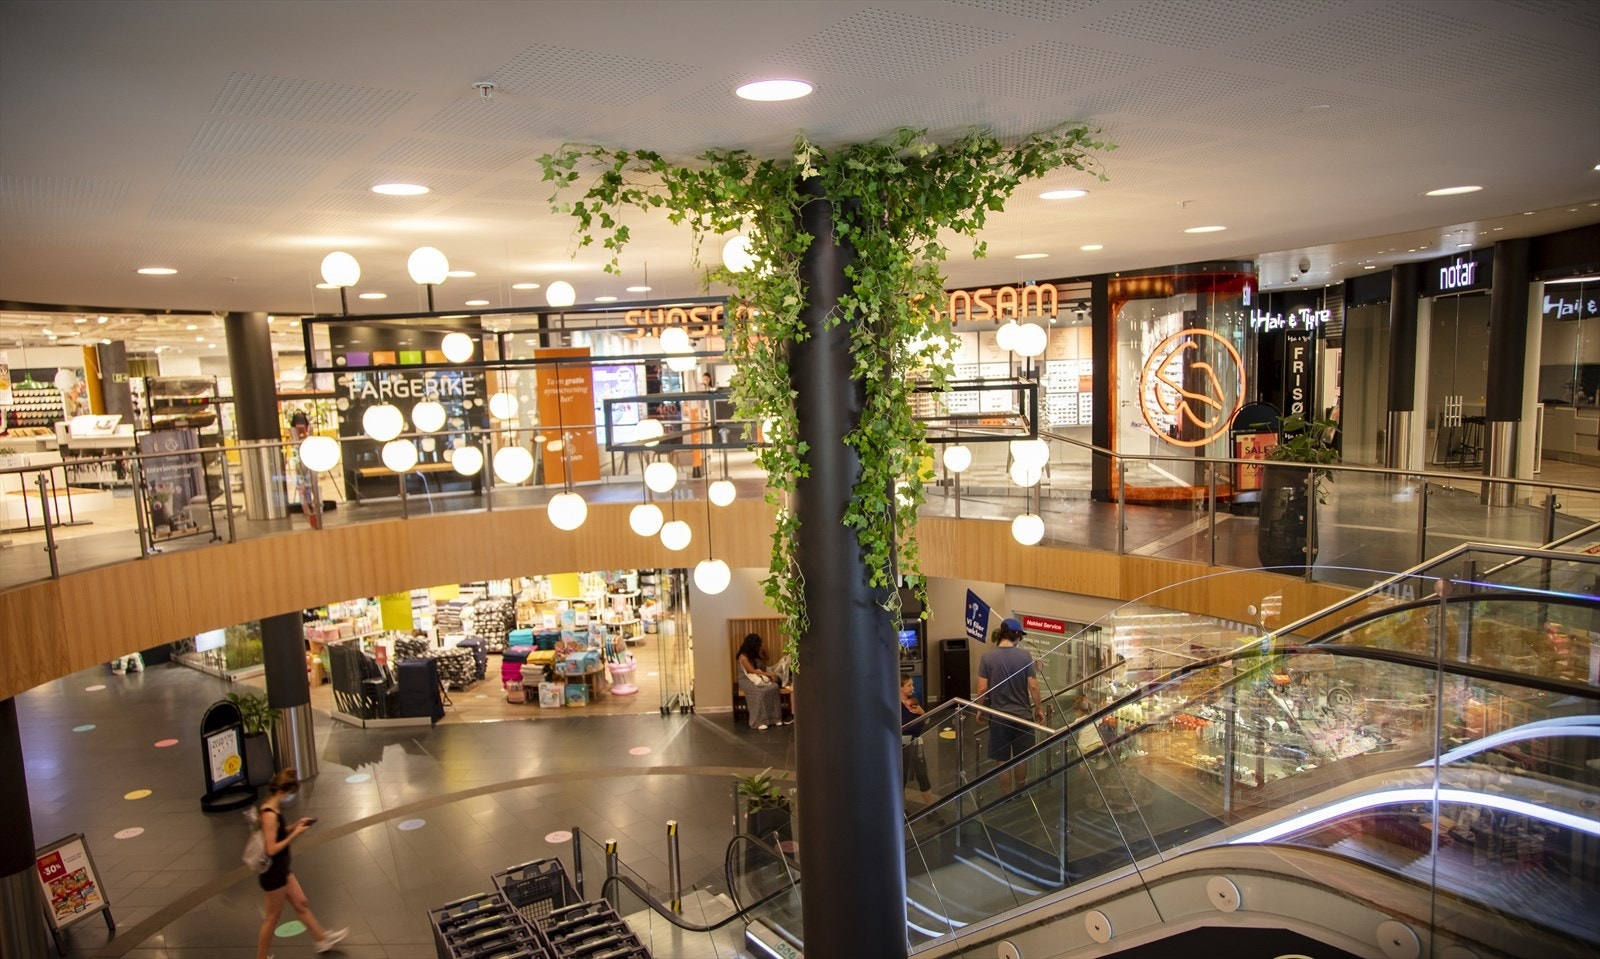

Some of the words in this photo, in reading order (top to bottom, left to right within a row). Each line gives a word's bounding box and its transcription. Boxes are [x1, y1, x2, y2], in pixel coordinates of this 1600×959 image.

[1440, 257, 1478, 290] notar
[901, 283, 1058, 324] NSAM
[1257, 309, 1286, 333] Hair
[348, 377, 476, 400] FARGERIKE
[1291, 347, 1304, 415] FRISØ
[1043, 621, 1062, 630] Service
